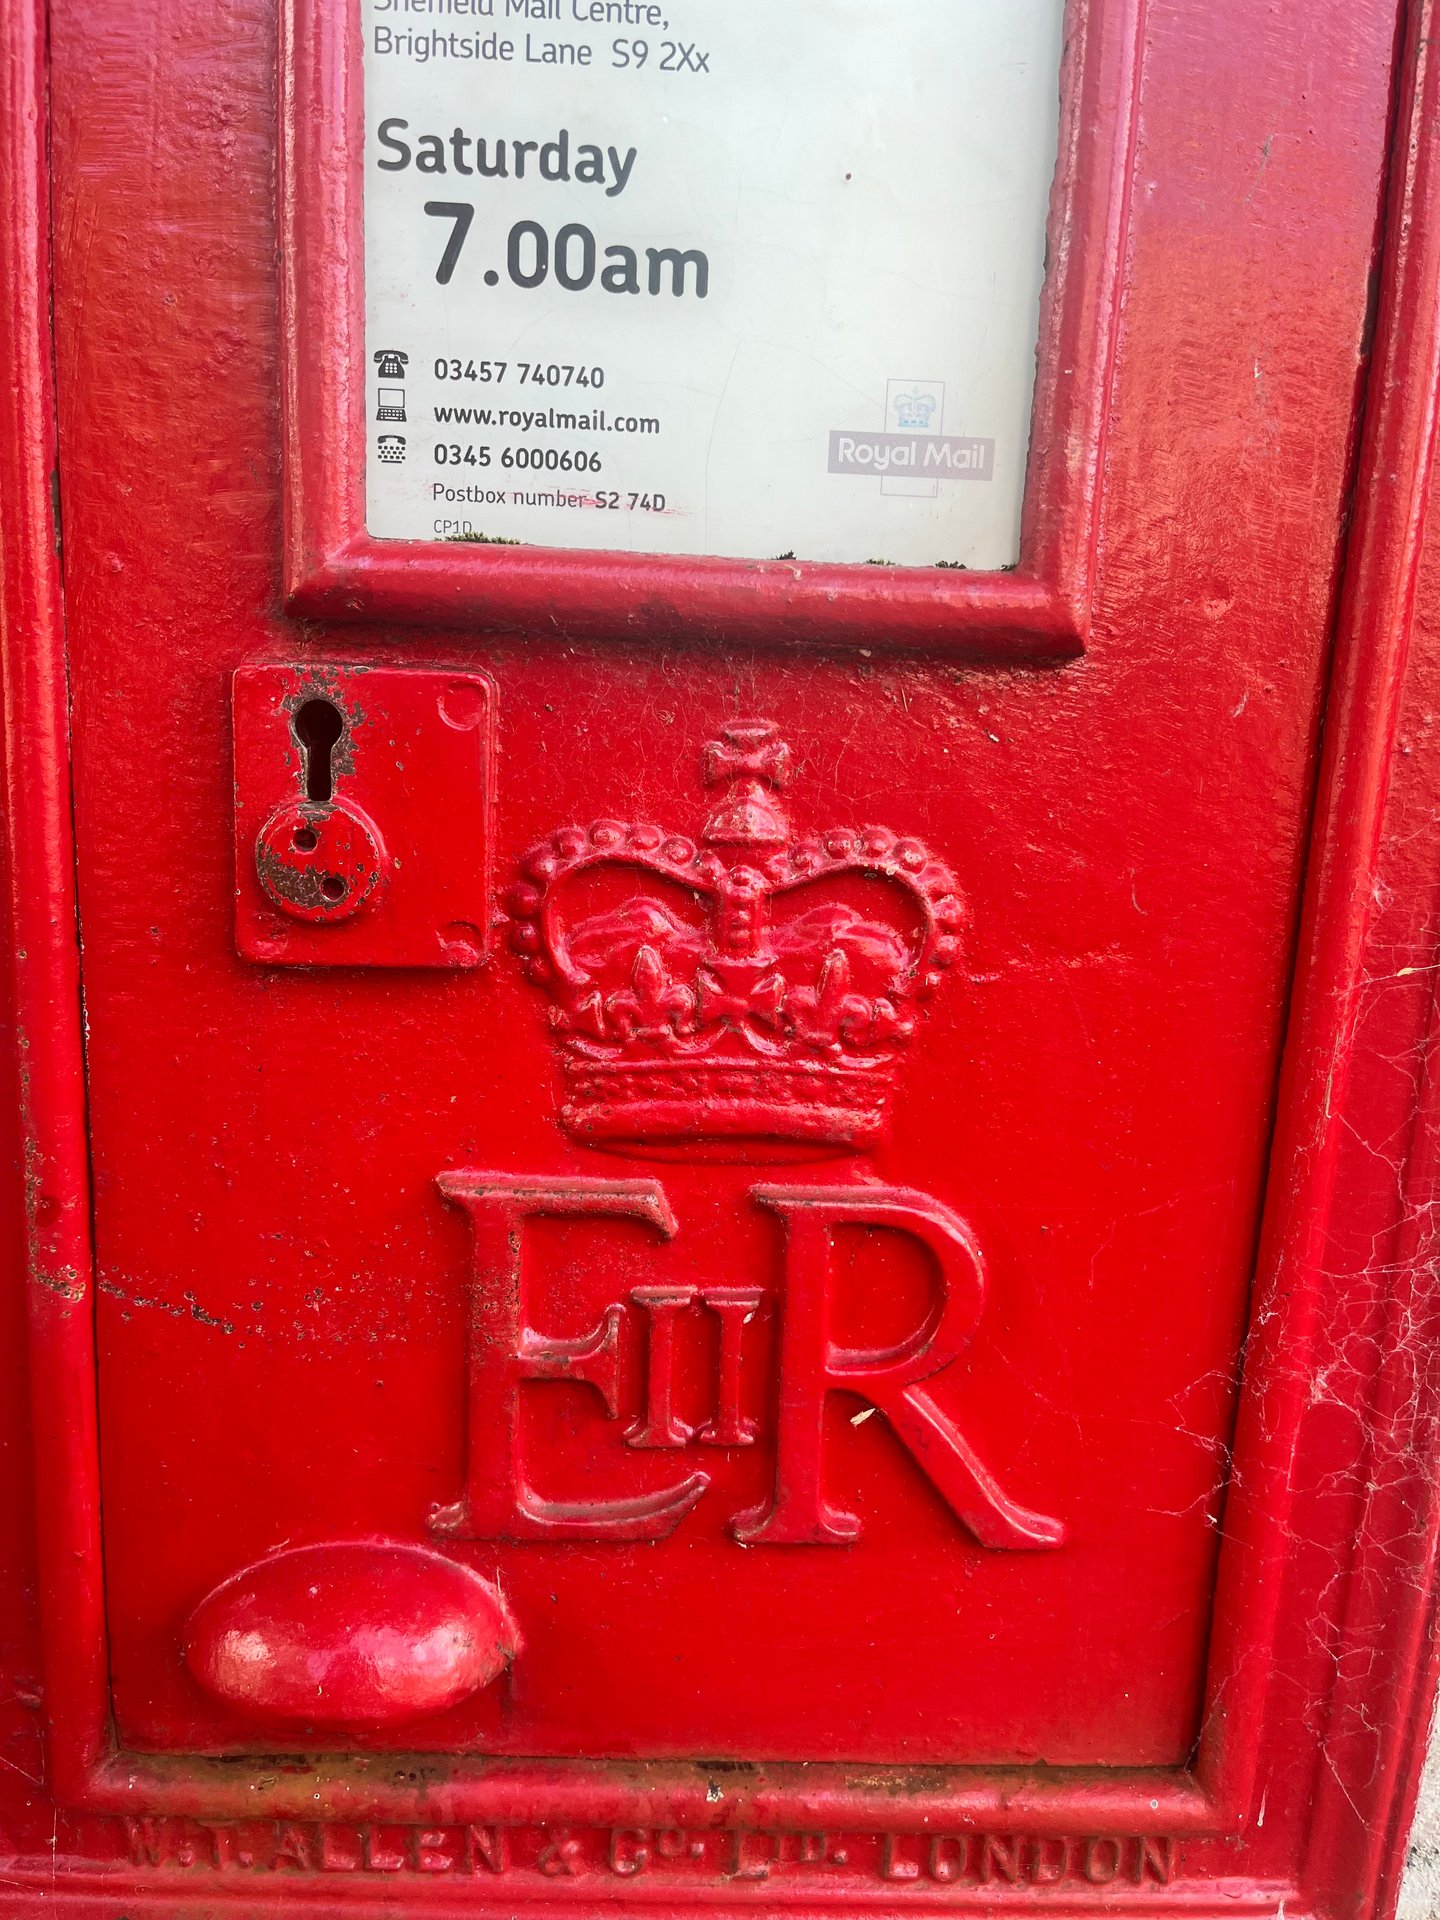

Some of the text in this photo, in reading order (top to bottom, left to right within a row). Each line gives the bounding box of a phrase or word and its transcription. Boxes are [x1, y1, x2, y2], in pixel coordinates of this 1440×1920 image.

[572, 0, 669, 31] Centre,
[374, 25, 710, 74] Brightside Lane S9 2Xx
[376, 117, 638, 198] Saturday
[423, 200, 709, 299] 7.00am
[434, 358, 605, 389] 03457 740740
[433, 406, 660, 434] www.royalmail.com
[434, 443, 602, 473] 0345 6000606
[838, 437, 985, 471] Royal Mail
[433, 482, 666, 512] Postbox number S2 74D
[433, 519, 473, 535] CP1D
[541, 1828, 583, 1879] &
[881, 1833, 1177, 1887] LONDON
